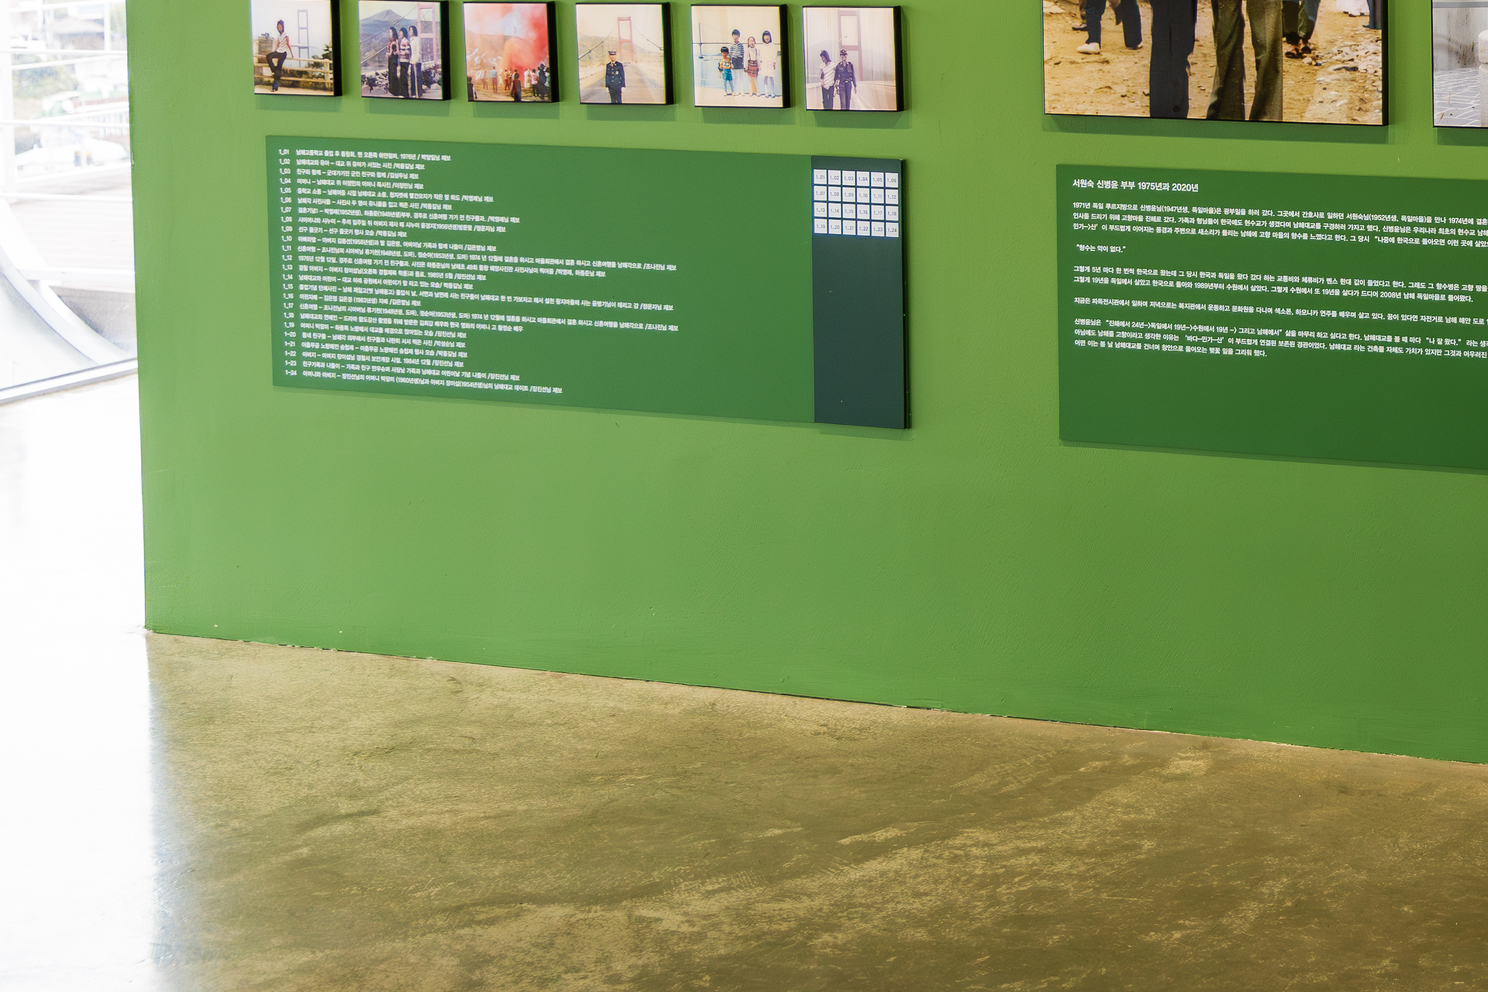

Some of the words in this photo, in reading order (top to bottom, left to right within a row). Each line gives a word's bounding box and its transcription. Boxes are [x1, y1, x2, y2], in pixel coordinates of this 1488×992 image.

[1072, 179, 1095, 188] 서원숙
[1120, 180, 1136, 190] 부부
[1137, 181, 1170, 191] 1975년과
[1171, 183, 1199, 192] 2020년
[1449, 217, 1474, 225] 1974년에
